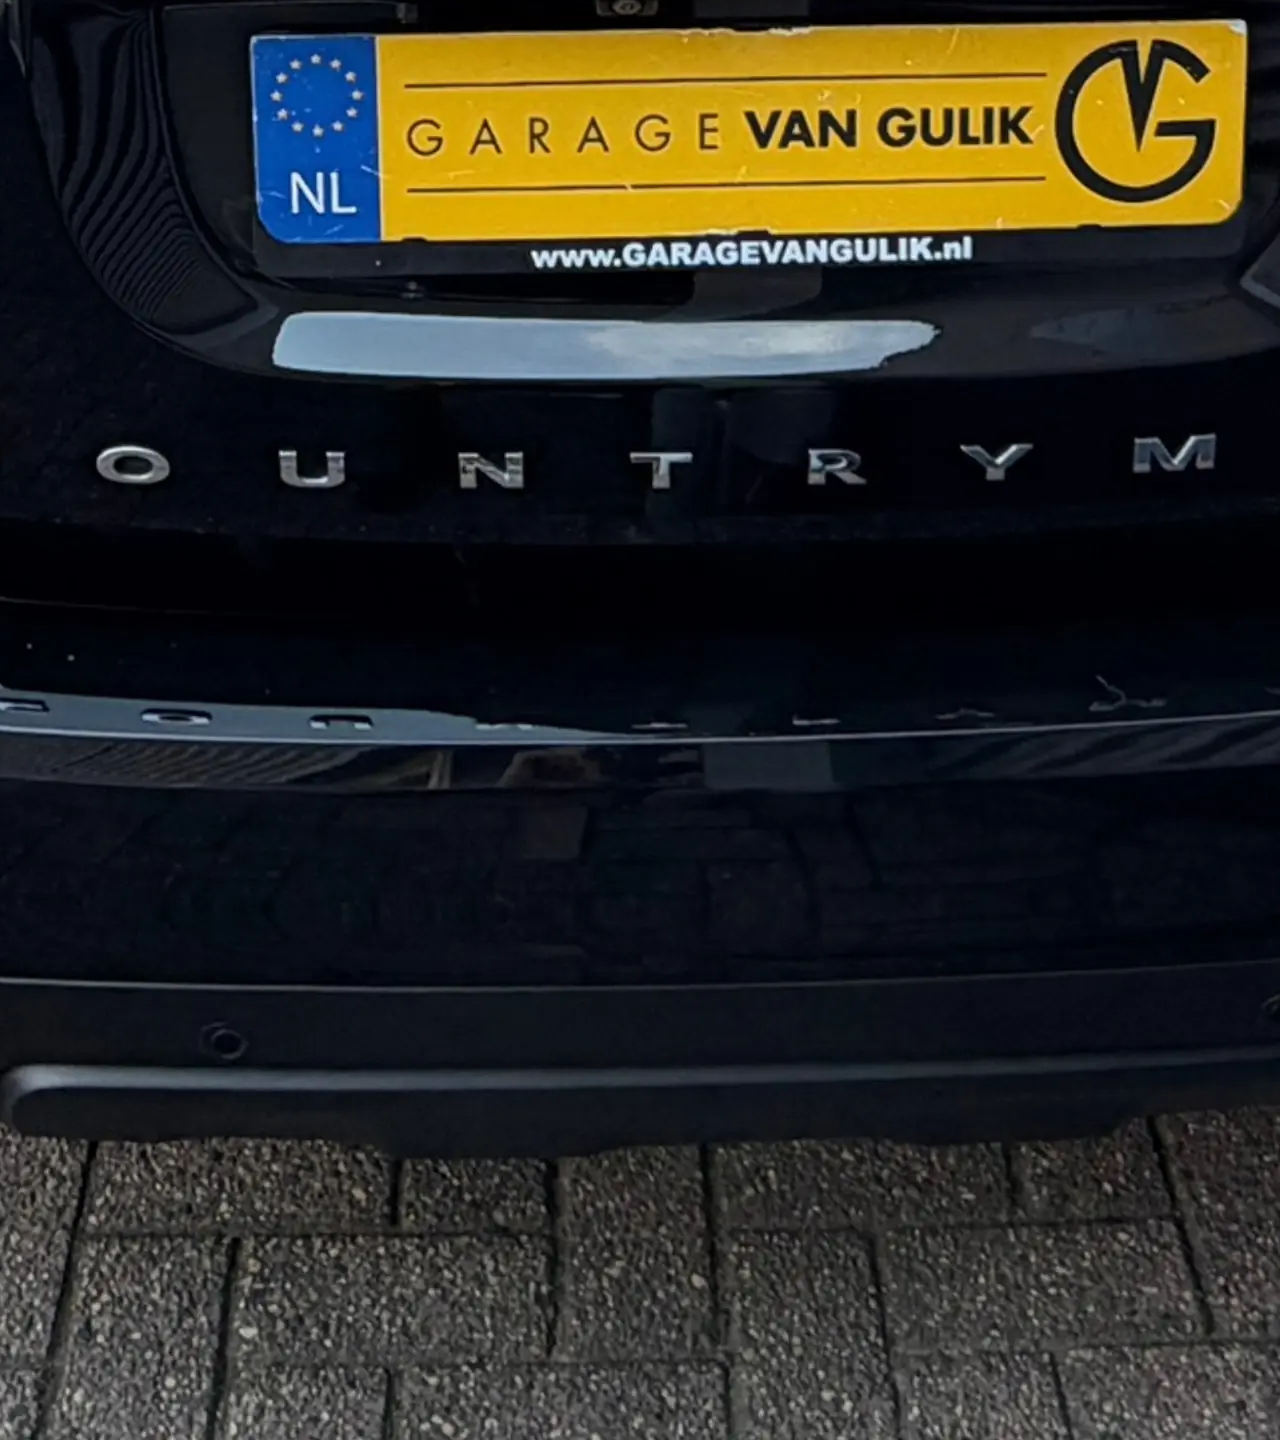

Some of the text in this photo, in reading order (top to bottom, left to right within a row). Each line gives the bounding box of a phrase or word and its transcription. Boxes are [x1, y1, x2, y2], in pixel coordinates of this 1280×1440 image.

[406, 105, 1036, 158] GARAGE VAN GULIK
[289, 171, 358, 215] NL
[529, 235, 974, 270] www.GARAGEVANGULIK.nl
